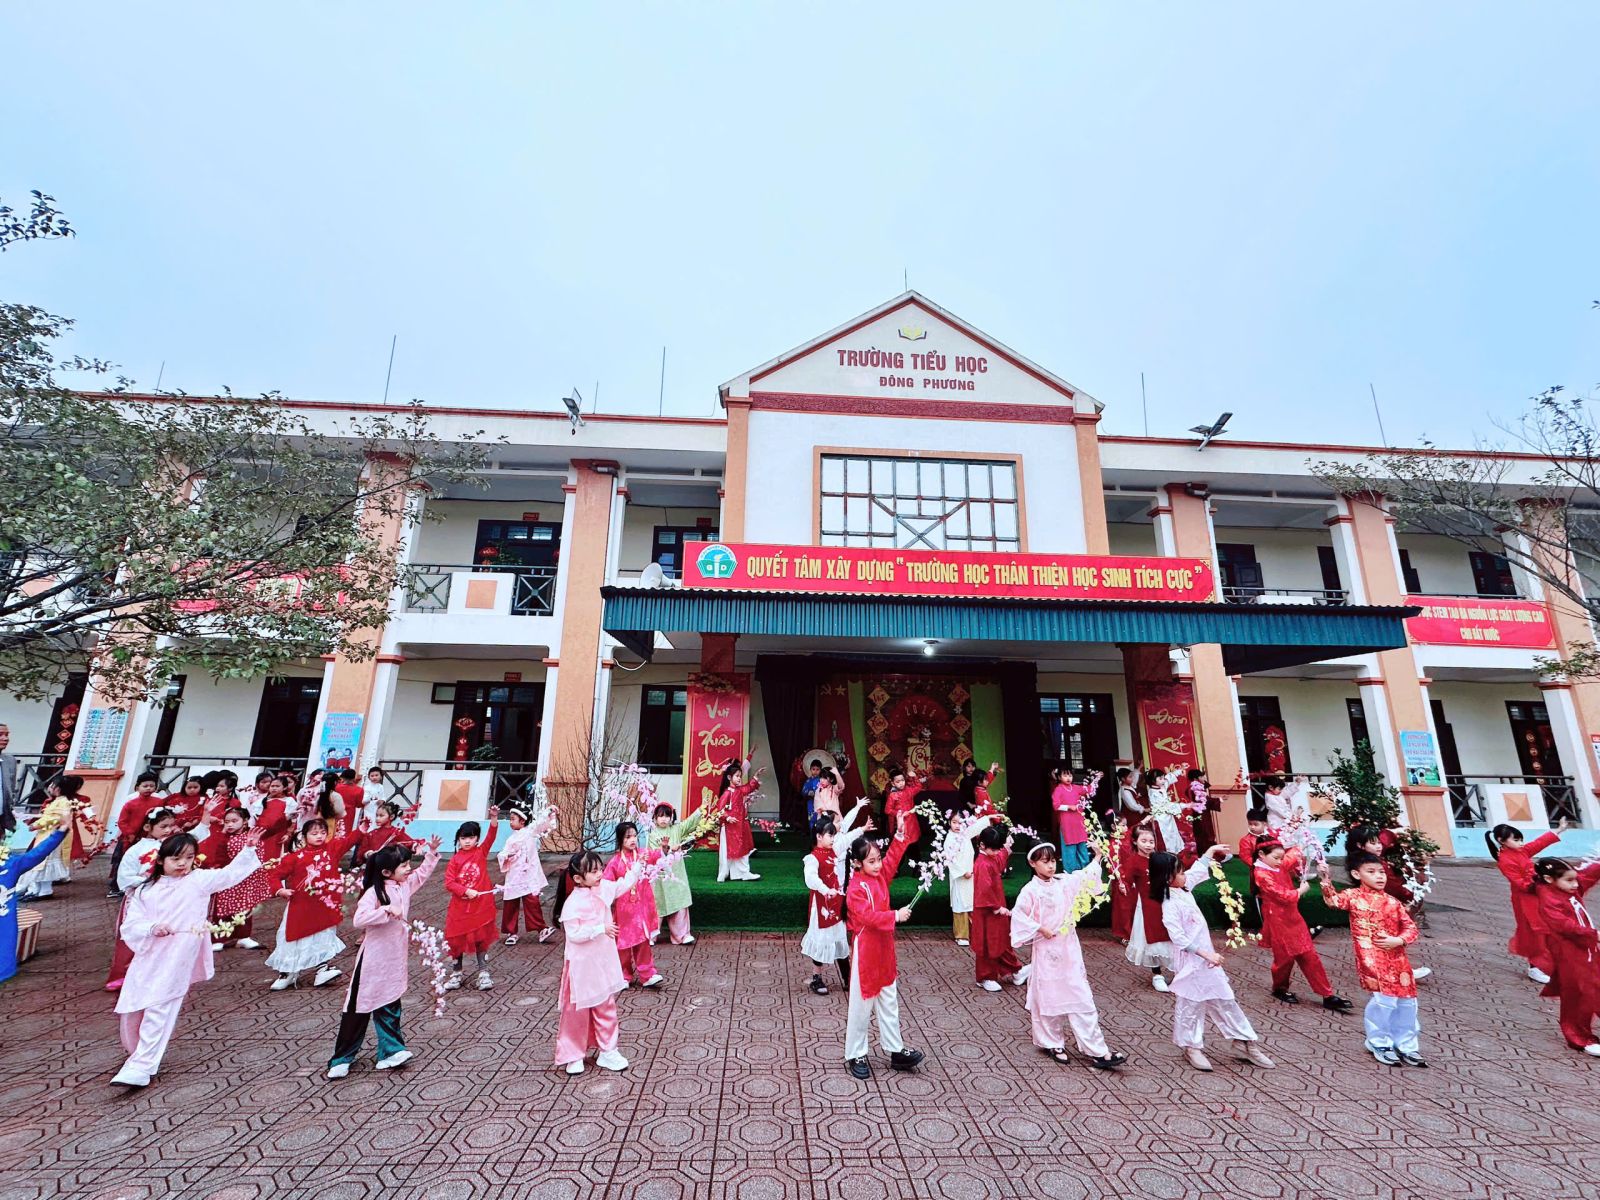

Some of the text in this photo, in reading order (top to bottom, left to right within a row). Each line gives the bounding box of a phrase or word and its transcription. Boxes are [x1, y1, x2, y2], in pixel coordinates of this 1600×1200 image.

[837, 346, 988, 376] TRƯỜNG TIỂU HỌC
[879, 374, 975, 391] ĐÔNG PHƯƠNG
[747, 551, 789, 580] QUYẾT
[794, 556, 822, 579] TÂM
[827, 555, 851, 580] XÂY
[857, 559, 894, 585] DỰNG
[963, 563, 989, 588] HỌC
[993, 560, 1029, 586] THÂN
[1031, 562, 1068, 590] THIỆN
[1073, 566, 1098, 591] HỌC
[1101, 566, 1132, 589] SINH
[1134, 564, 1164, 589] TÍCH
[706, 697, 730, 719] Vui
[1148, 708, 1188, 725] Đoàn
[698, 723, 735, 764] Xuân
[1154, 733, 1191, 756] Kết
